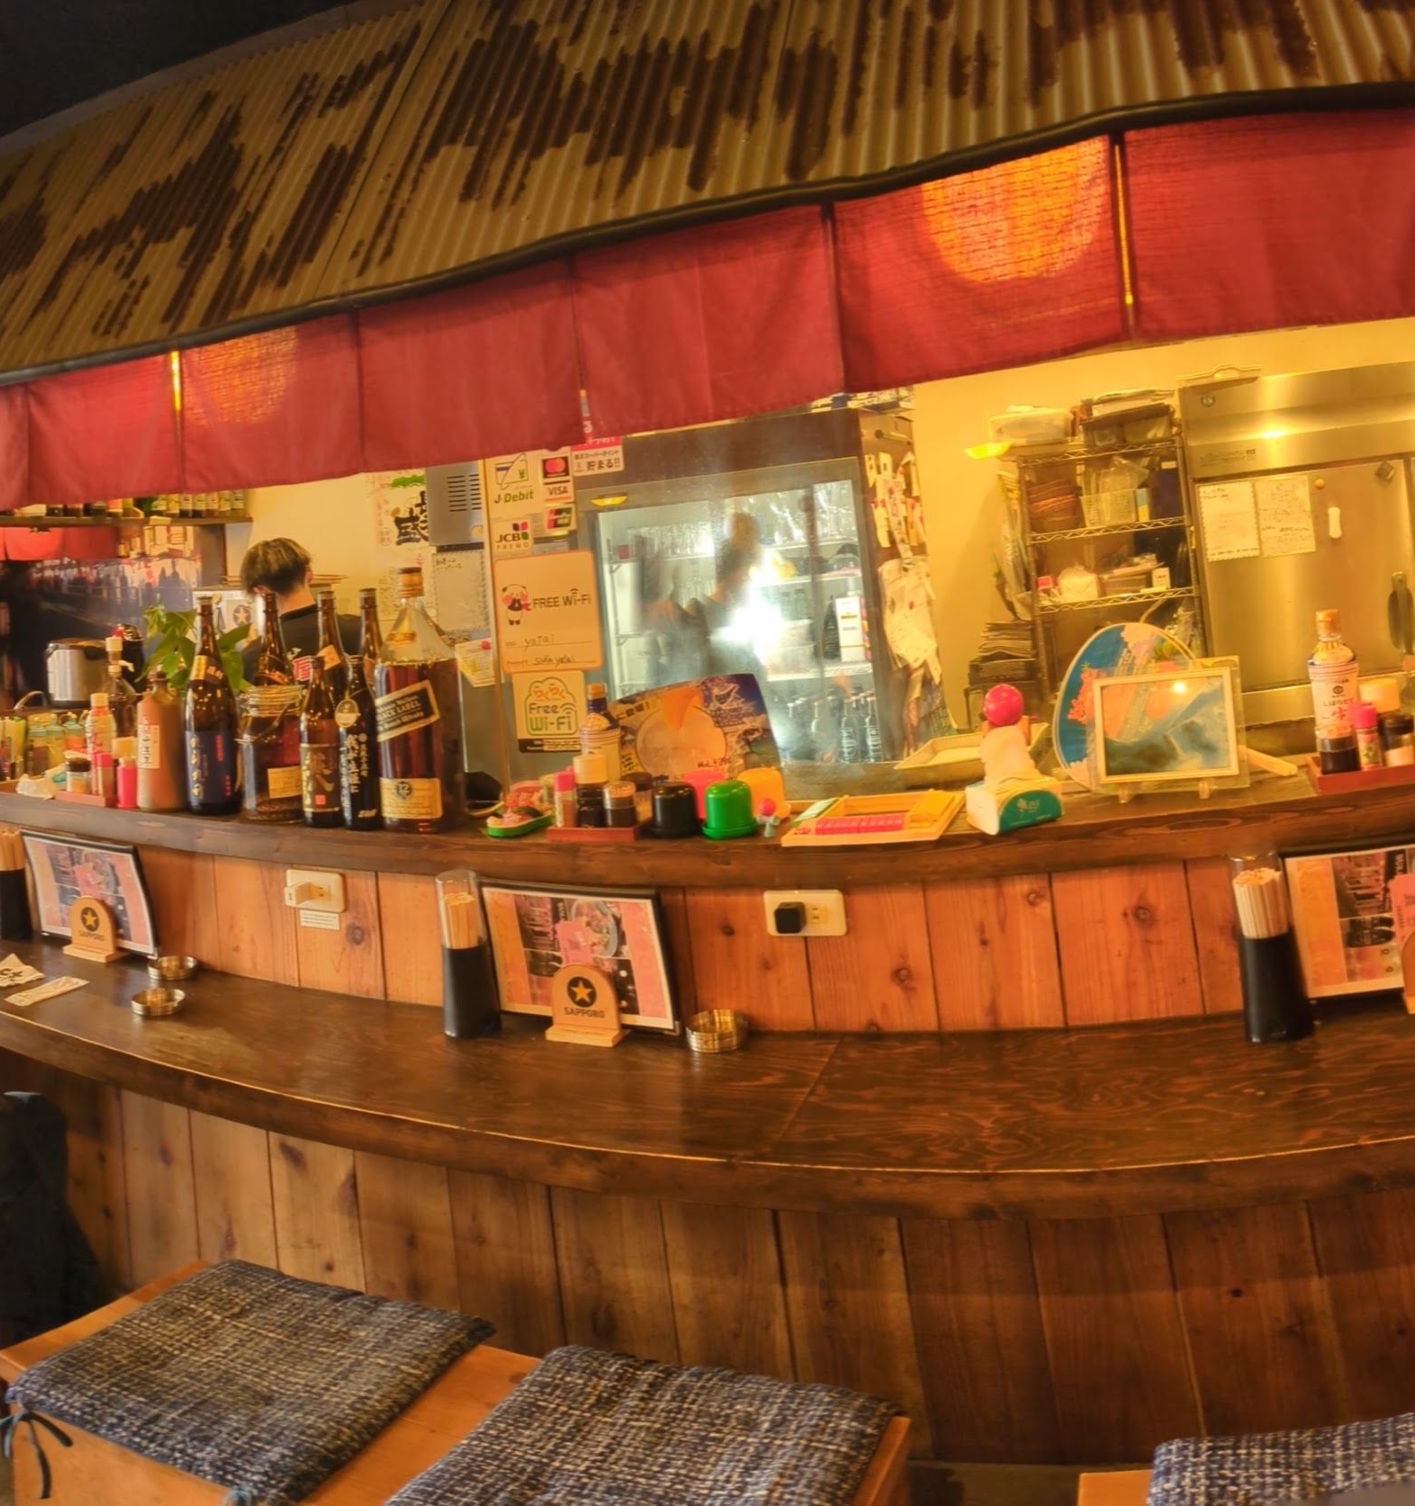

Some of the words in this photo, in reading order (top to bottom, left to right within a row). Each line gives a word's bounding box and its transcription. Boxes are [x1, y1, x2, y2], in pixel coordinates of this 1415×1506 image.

[494, 490, 535, 504] J-Debit
[547, 486, 569, 496] VISA
[495, 533, 521, 543] JCB
[533, 597, 560, 609] FREE
[562, 594, 592, 607] Wi-Fi
[396, 700, 421, 712] LABEL
[529, 702, 559, 714] Free
[529, 713, 572, 732] Wi-Fi
[564, 1006, 605, 1019] SAPPORO
